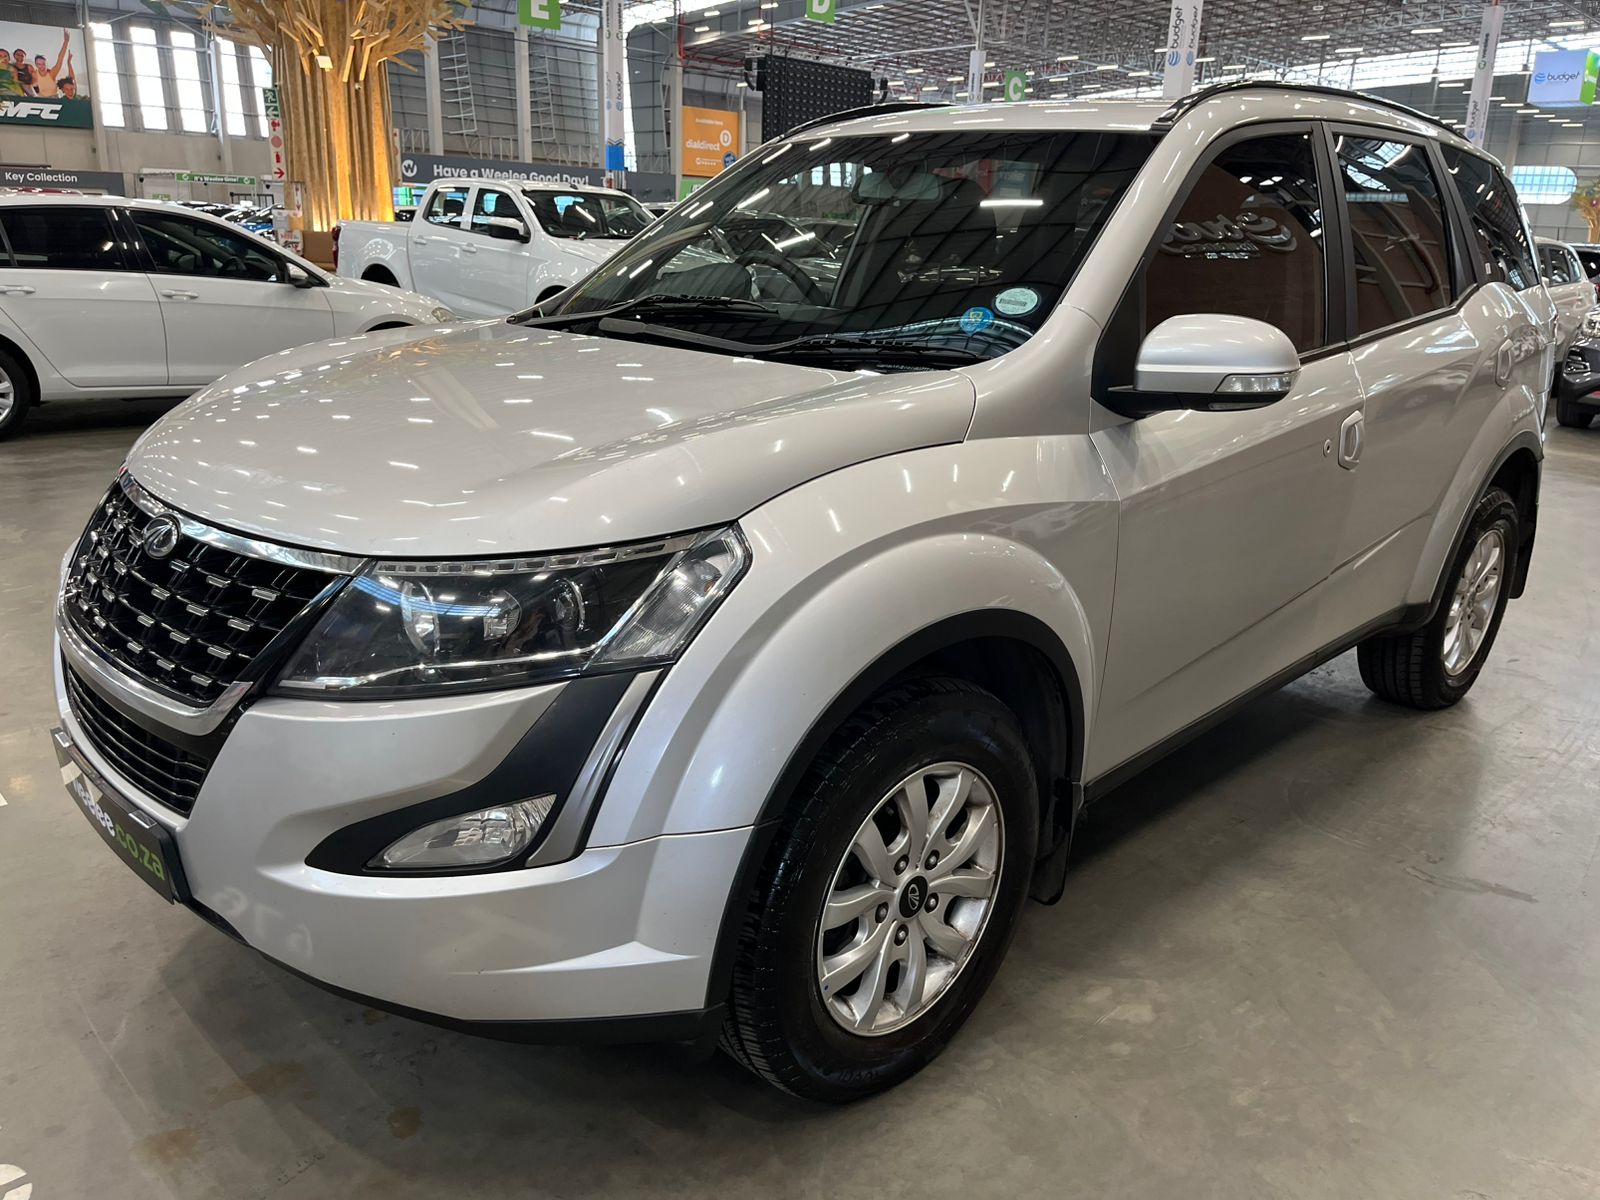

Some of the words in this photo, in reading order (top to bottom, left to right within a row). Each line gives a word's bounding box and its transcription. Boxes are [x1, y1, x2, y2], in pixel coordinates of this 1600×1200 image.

[1170, 6, 1185, 48] budget
[1546, 71, 1580, 84] budget
[1009, 77, 1022, 101] C
[0, 101, 63, 120] MFC
[5, 172, 24, 183] Key
[27, 173, 78, 182] Collection
[433, 164, 468, 179] Have
[470, 169, 479, 178] a
[481, 168, 527, 181] Weelee
[529, 171, 560, 184] Good
